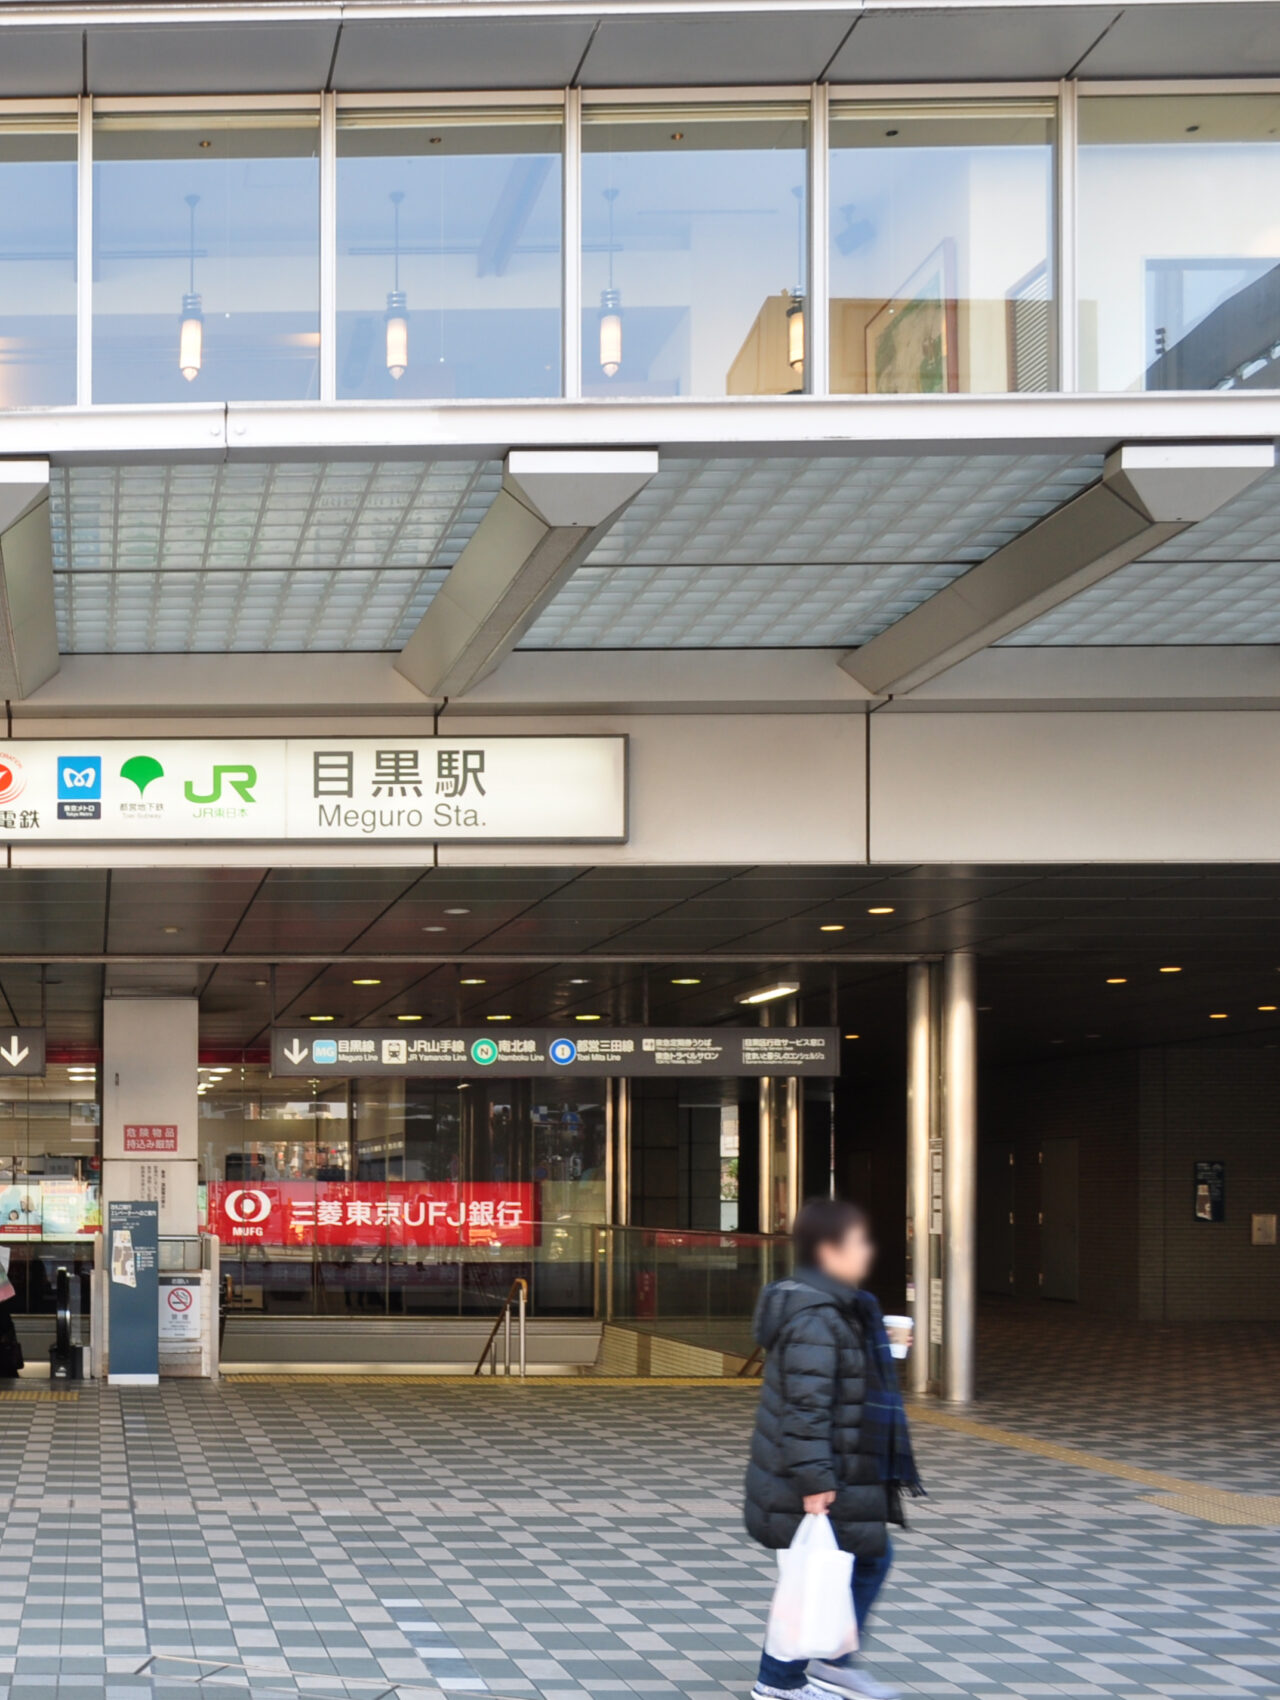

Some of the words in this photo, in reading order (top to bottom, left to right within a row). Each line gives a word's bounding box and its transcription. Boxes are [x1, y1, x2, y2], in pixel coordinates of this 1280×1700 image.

[313, 750, 487, 798] 目黒駅
[184, 765, 257, 804] JR
[192, 807, 249, 818] JR東日本
[318, 804, 423, 833] Meguro
[434, 803, 487, 827] Sta.
[315, 1046, 335, 1057] MG
[338, 1040, 375, 1052] 目黒線
[408, 1040, 466, 1053] JR山手線
[480, 1047, 489, 1056] N
[498, 1040, 536, 1053] 南北線
[577, 1040, 634, 1053] 都営三田線
[126, 1127, 175, 1138] 危険物品
[290, 1200, 523, 1228] 三菱東京UFJ銀行
[232, 1226, 263, 1237] MUFG
